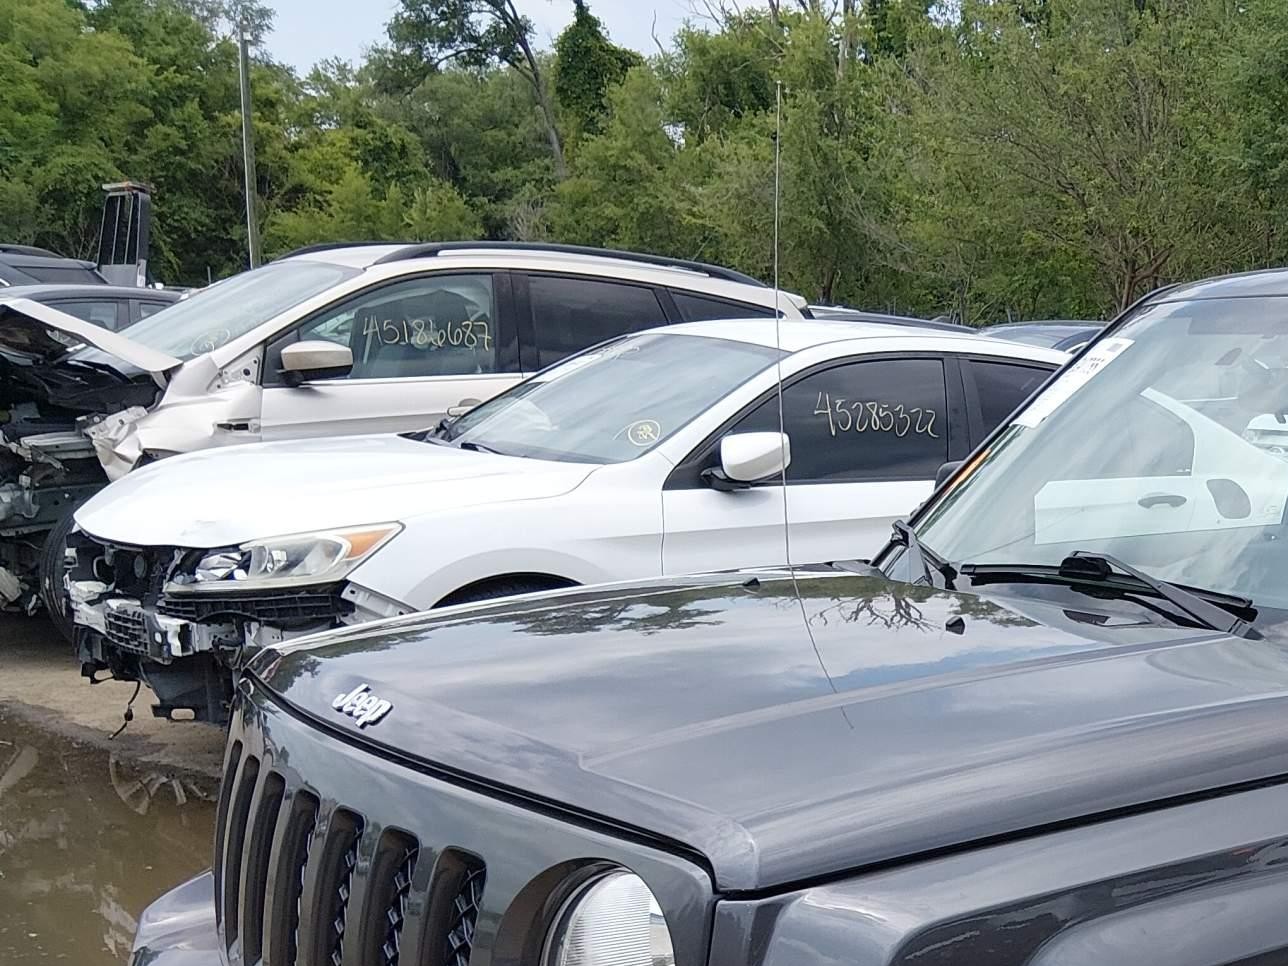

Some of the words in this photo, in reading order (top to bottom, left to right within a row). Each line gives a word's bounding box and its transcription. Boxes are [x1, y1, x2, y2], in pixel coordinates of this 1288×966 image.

[363, 314, 492, 351] 45186687
[814, 391, 939, 438] 45285322
[332, 683, 393, 729] Jeep
